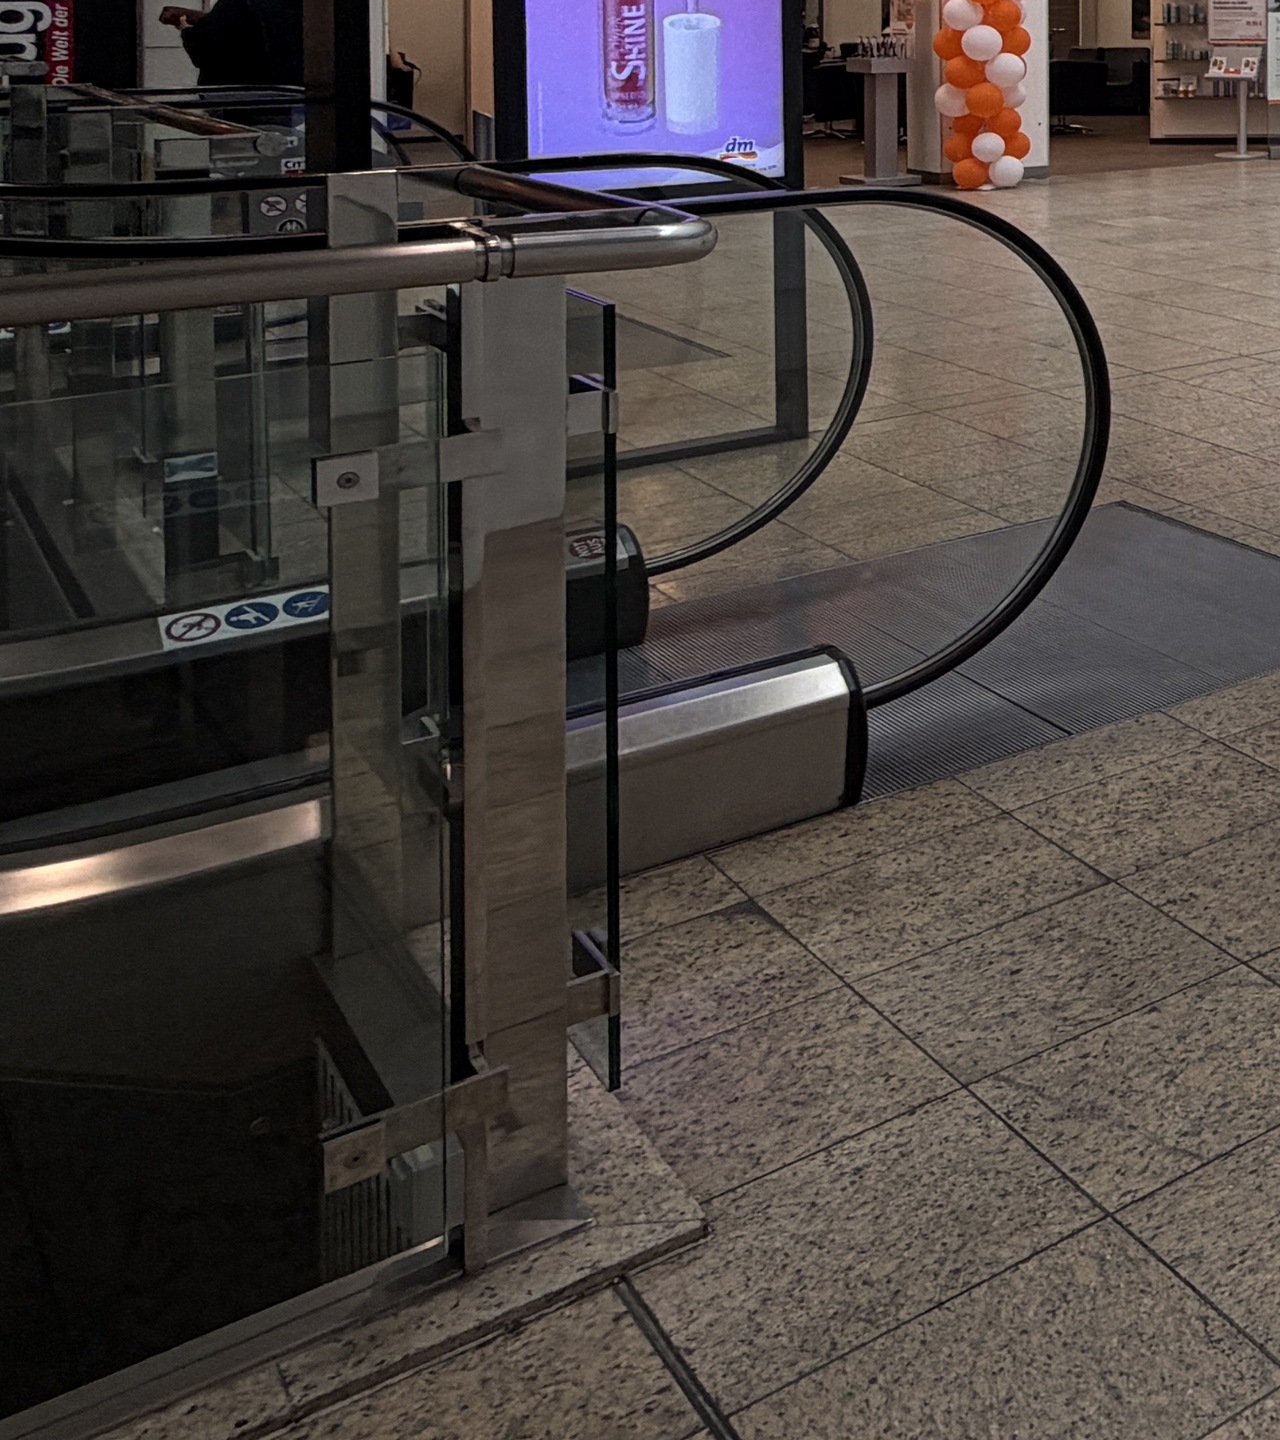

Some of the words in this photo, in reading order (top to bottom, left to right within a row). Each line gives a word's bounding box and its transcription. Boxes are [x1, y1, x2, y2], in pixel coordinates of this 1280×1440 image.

[51, 2, 70, 28] der
[51, 29, 70, 62] Welt
[610, 3, 647, 88] SHINE
[725, 137, 754, 153] dm
